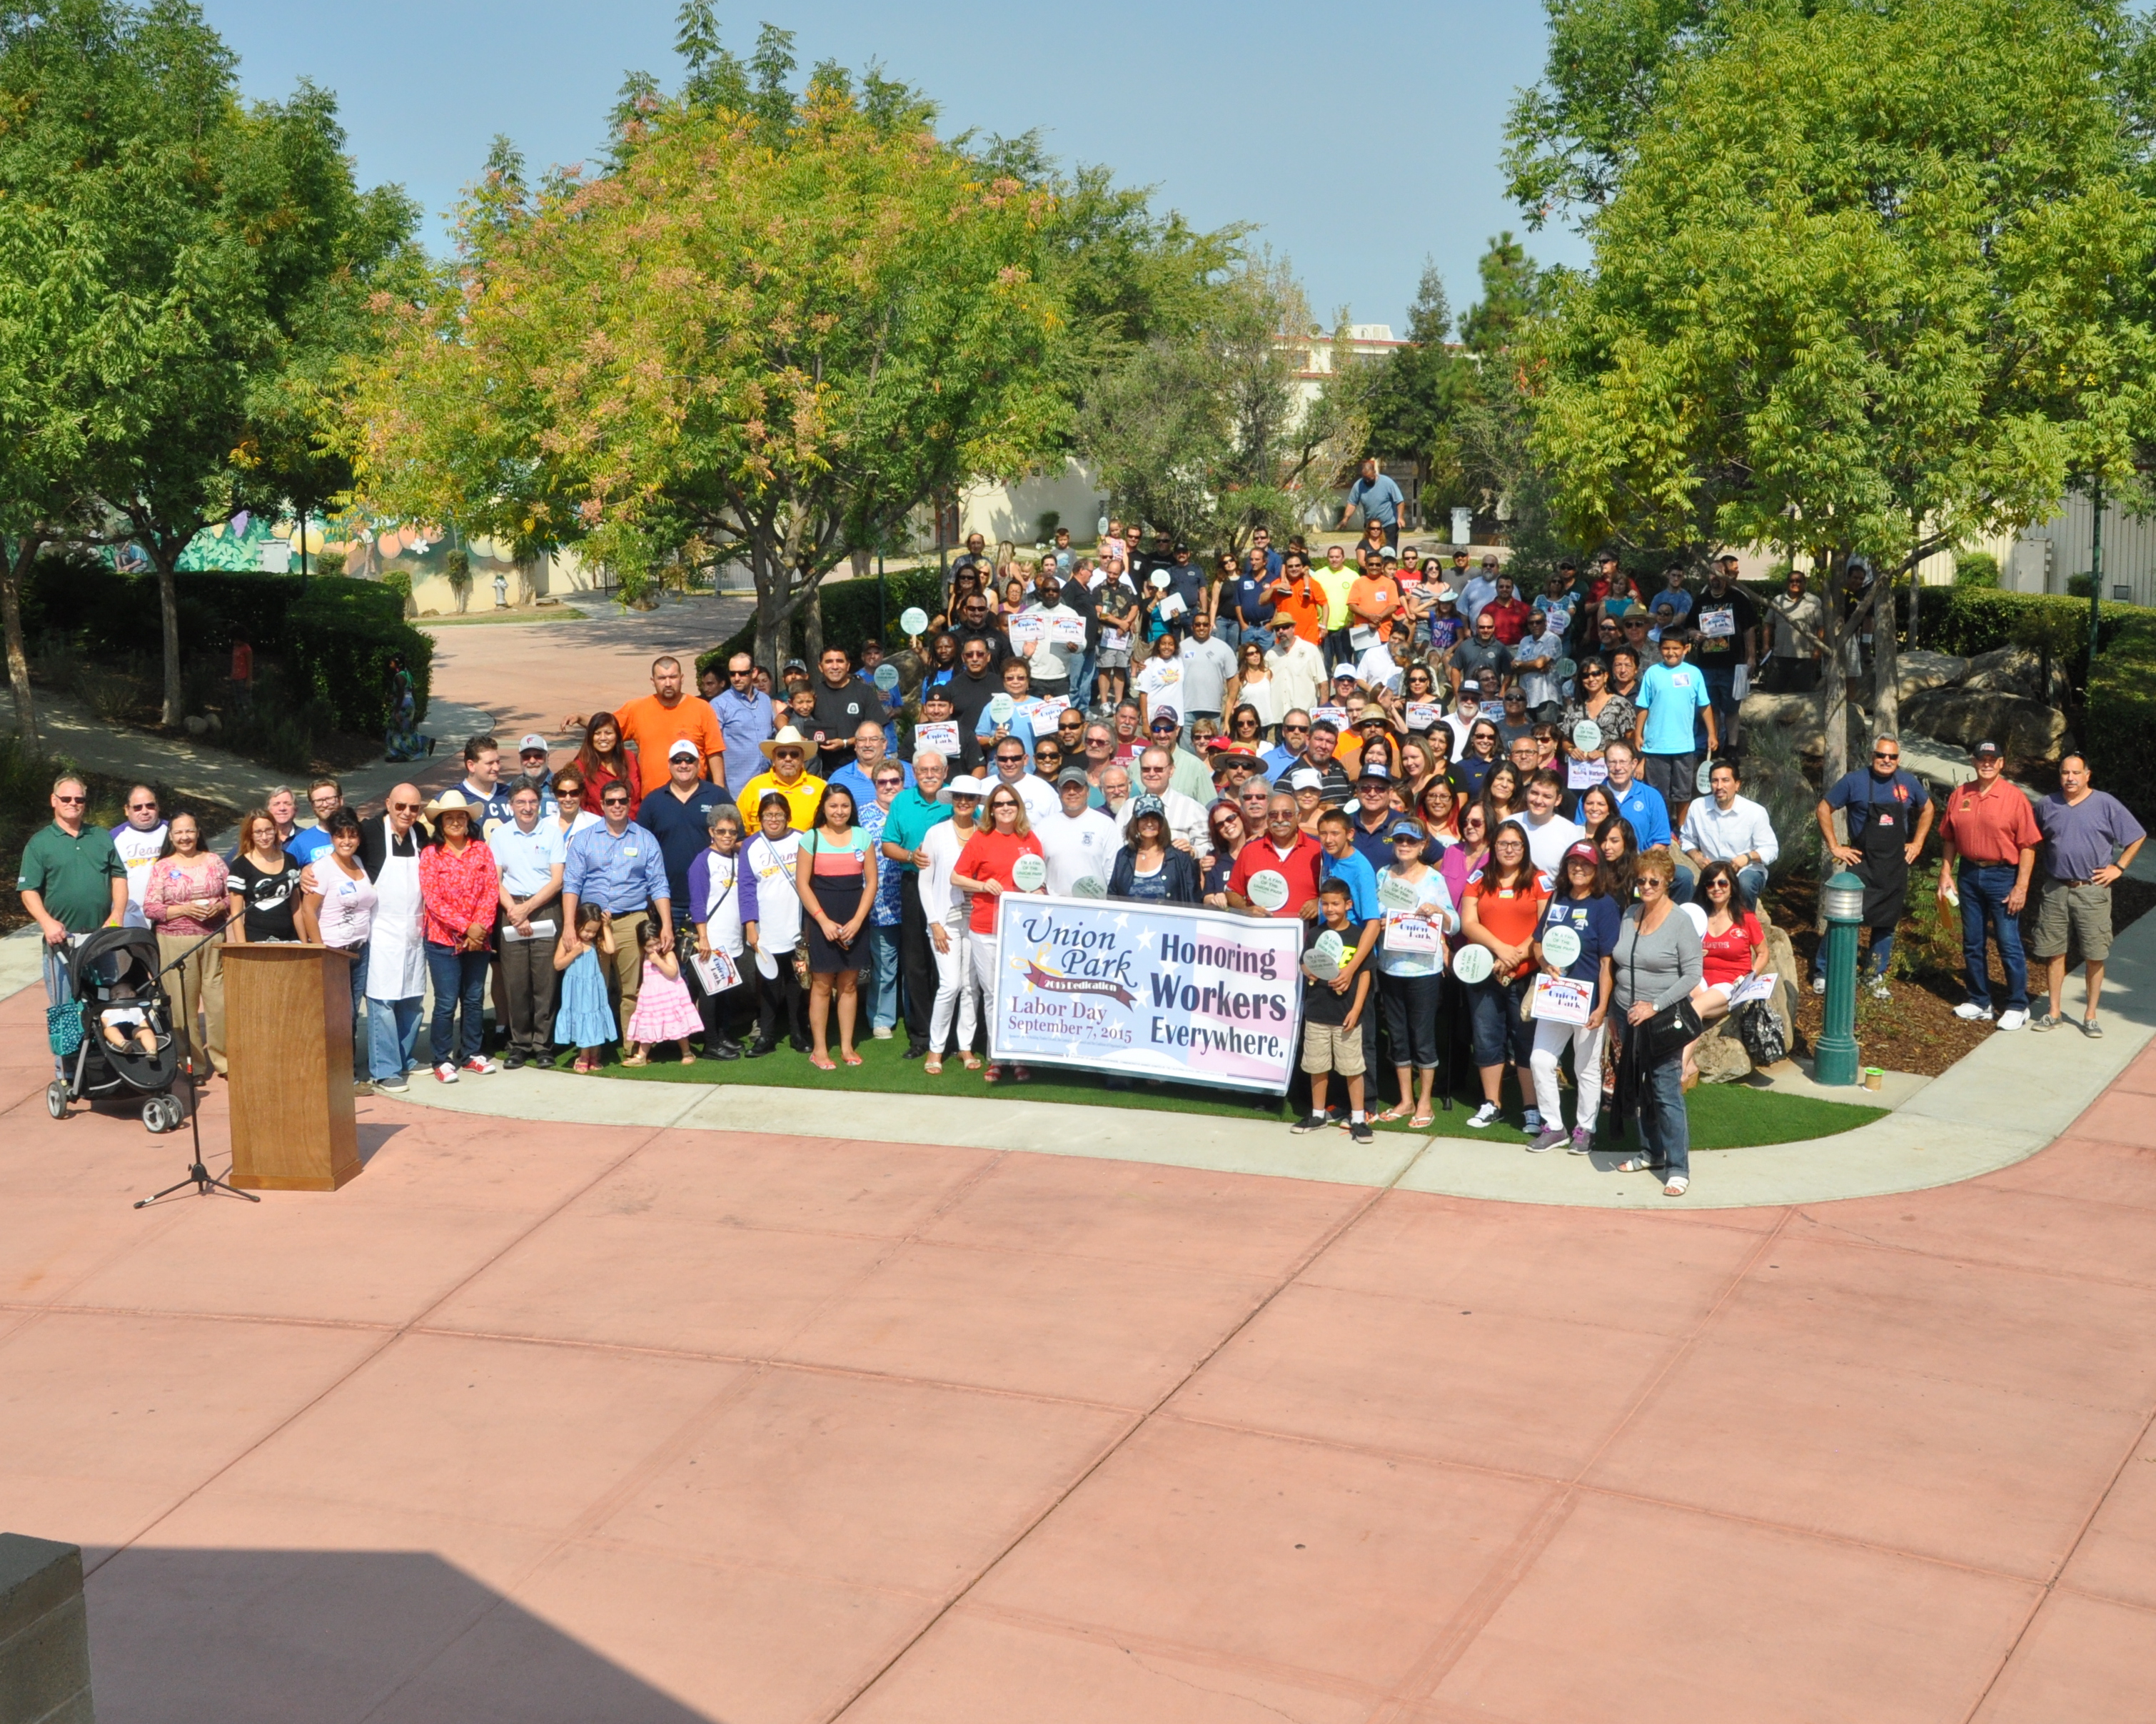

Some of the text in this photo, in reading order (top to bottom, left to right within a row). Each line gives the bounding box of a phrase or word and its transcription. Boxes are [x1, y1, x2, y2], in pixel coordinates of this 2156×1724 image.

[1022, 916, 1116, 950] Union
[1061, 949, 1138, 988] Park
[1160, 933, 1277, 981] Honoring
[1044, 979, 1117, 992] 2015 Dedication
[1150, 972, 1287, 1022] Workers
[1012, 996, 1107, 1025] Labor Day
[1008, 1015, 1083, 1035] September
[1085, 1026, 1097, 1040] 7,
[1101, 1027, 1132, 1044] 2015
[1151, 1016, 1284, 1058] Everywhere.
